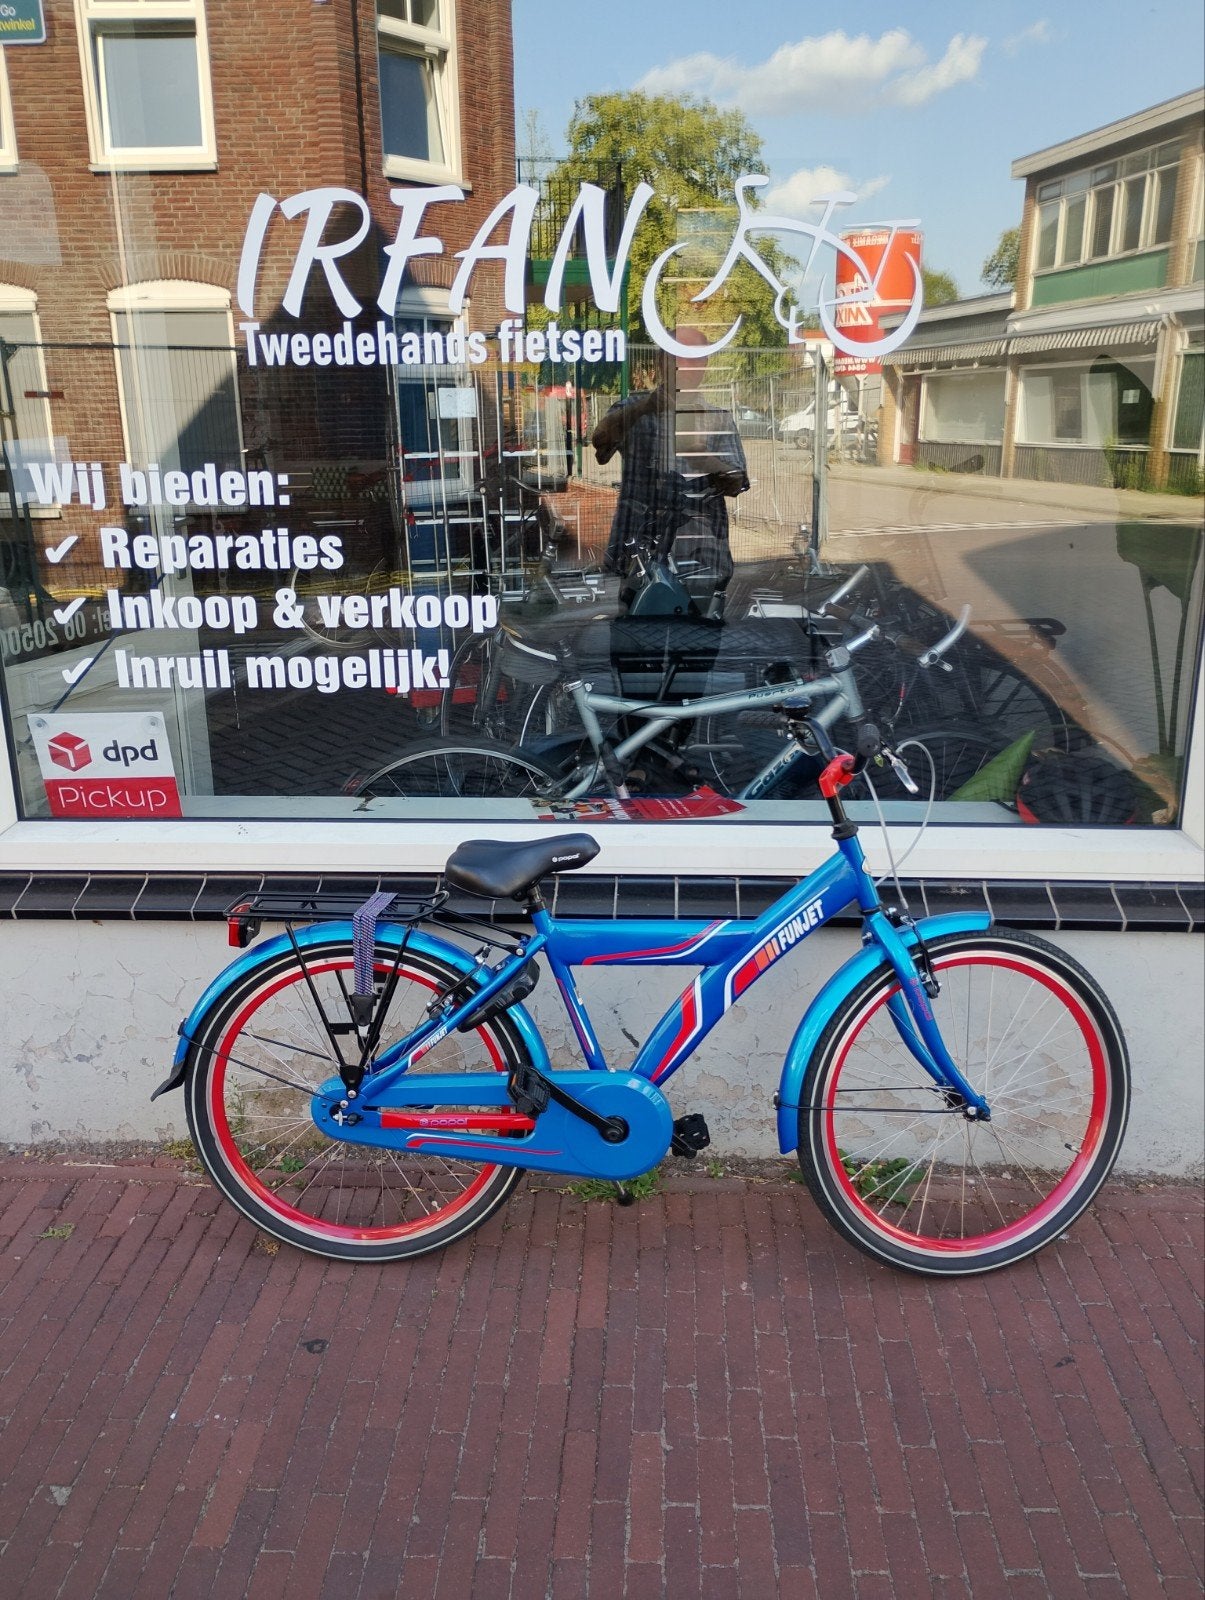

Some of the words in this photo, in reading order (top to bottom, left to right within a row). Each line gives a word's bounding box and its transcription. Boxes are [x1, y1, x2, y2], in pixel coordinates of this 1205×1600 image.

[237, 183, 655, 318] IRFAN
[239, 320, 487, 366] Tweedehands
[499, 318, 626, 363] fietsen
[28, 462, 106, 511] Wij
[120, 462, 291, 506] bieden:
[100, 527, 344, 574] Reparaties
[107, 588, 258, 634] Inkoop
[273, 587, 305, 629] &
[317, 588, 498, 633] verkoop
[115, 649, 232, 689] Inruil
[246, 649, 451, 694] mogelijk!
[748, 687, 795, 700] Puerto
[102, 738, 159, 767] dpd
[58, 785, 167, 812] Pickup
[777, 898, 825, 951] FUNJET
